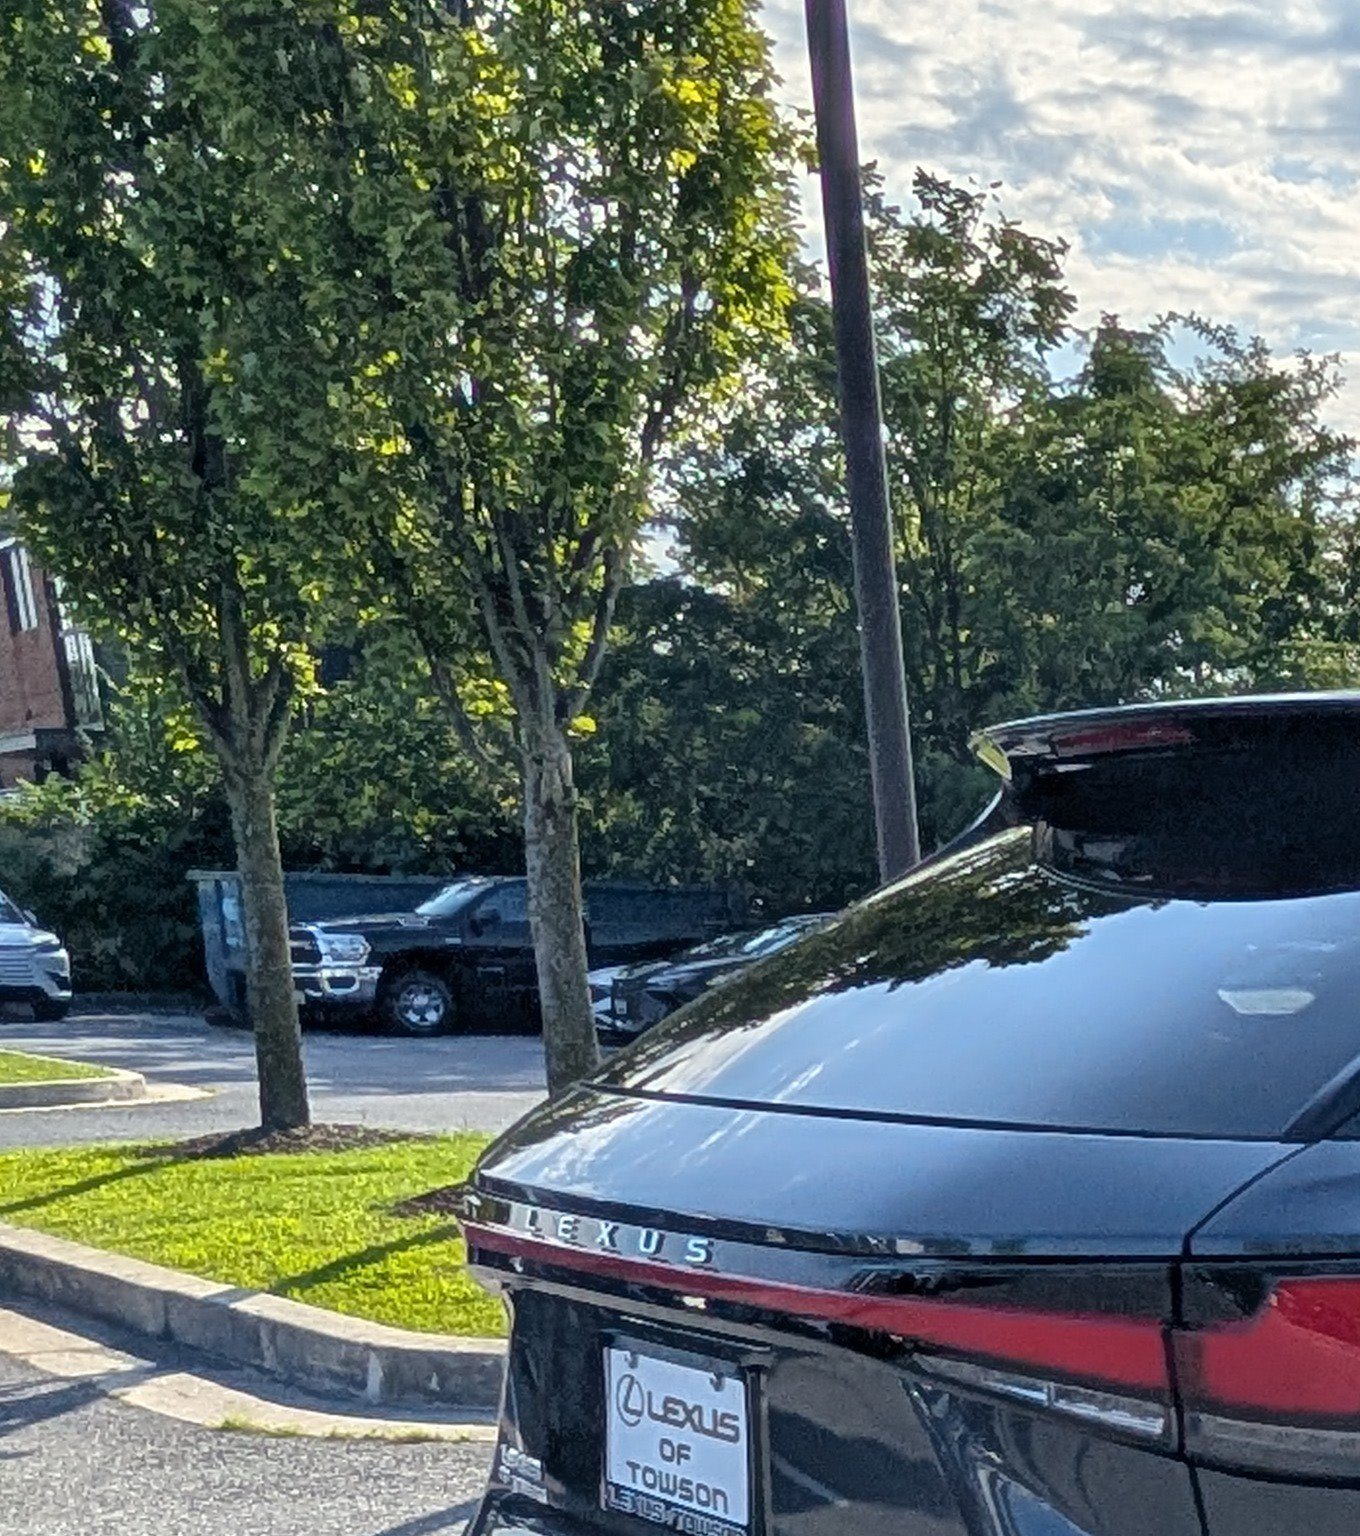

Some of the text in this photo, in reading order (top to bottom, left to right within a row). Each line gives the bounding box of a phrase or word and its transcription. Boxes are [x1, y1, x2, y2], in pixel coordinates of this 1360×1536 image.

[525, 1208, 712, 1264] LEXUS
[646, 1390, 741, 1444] LEXUS
[658, 1437, 692, 1466] OF
[625, 1460, 730, 1516] TOWSON
